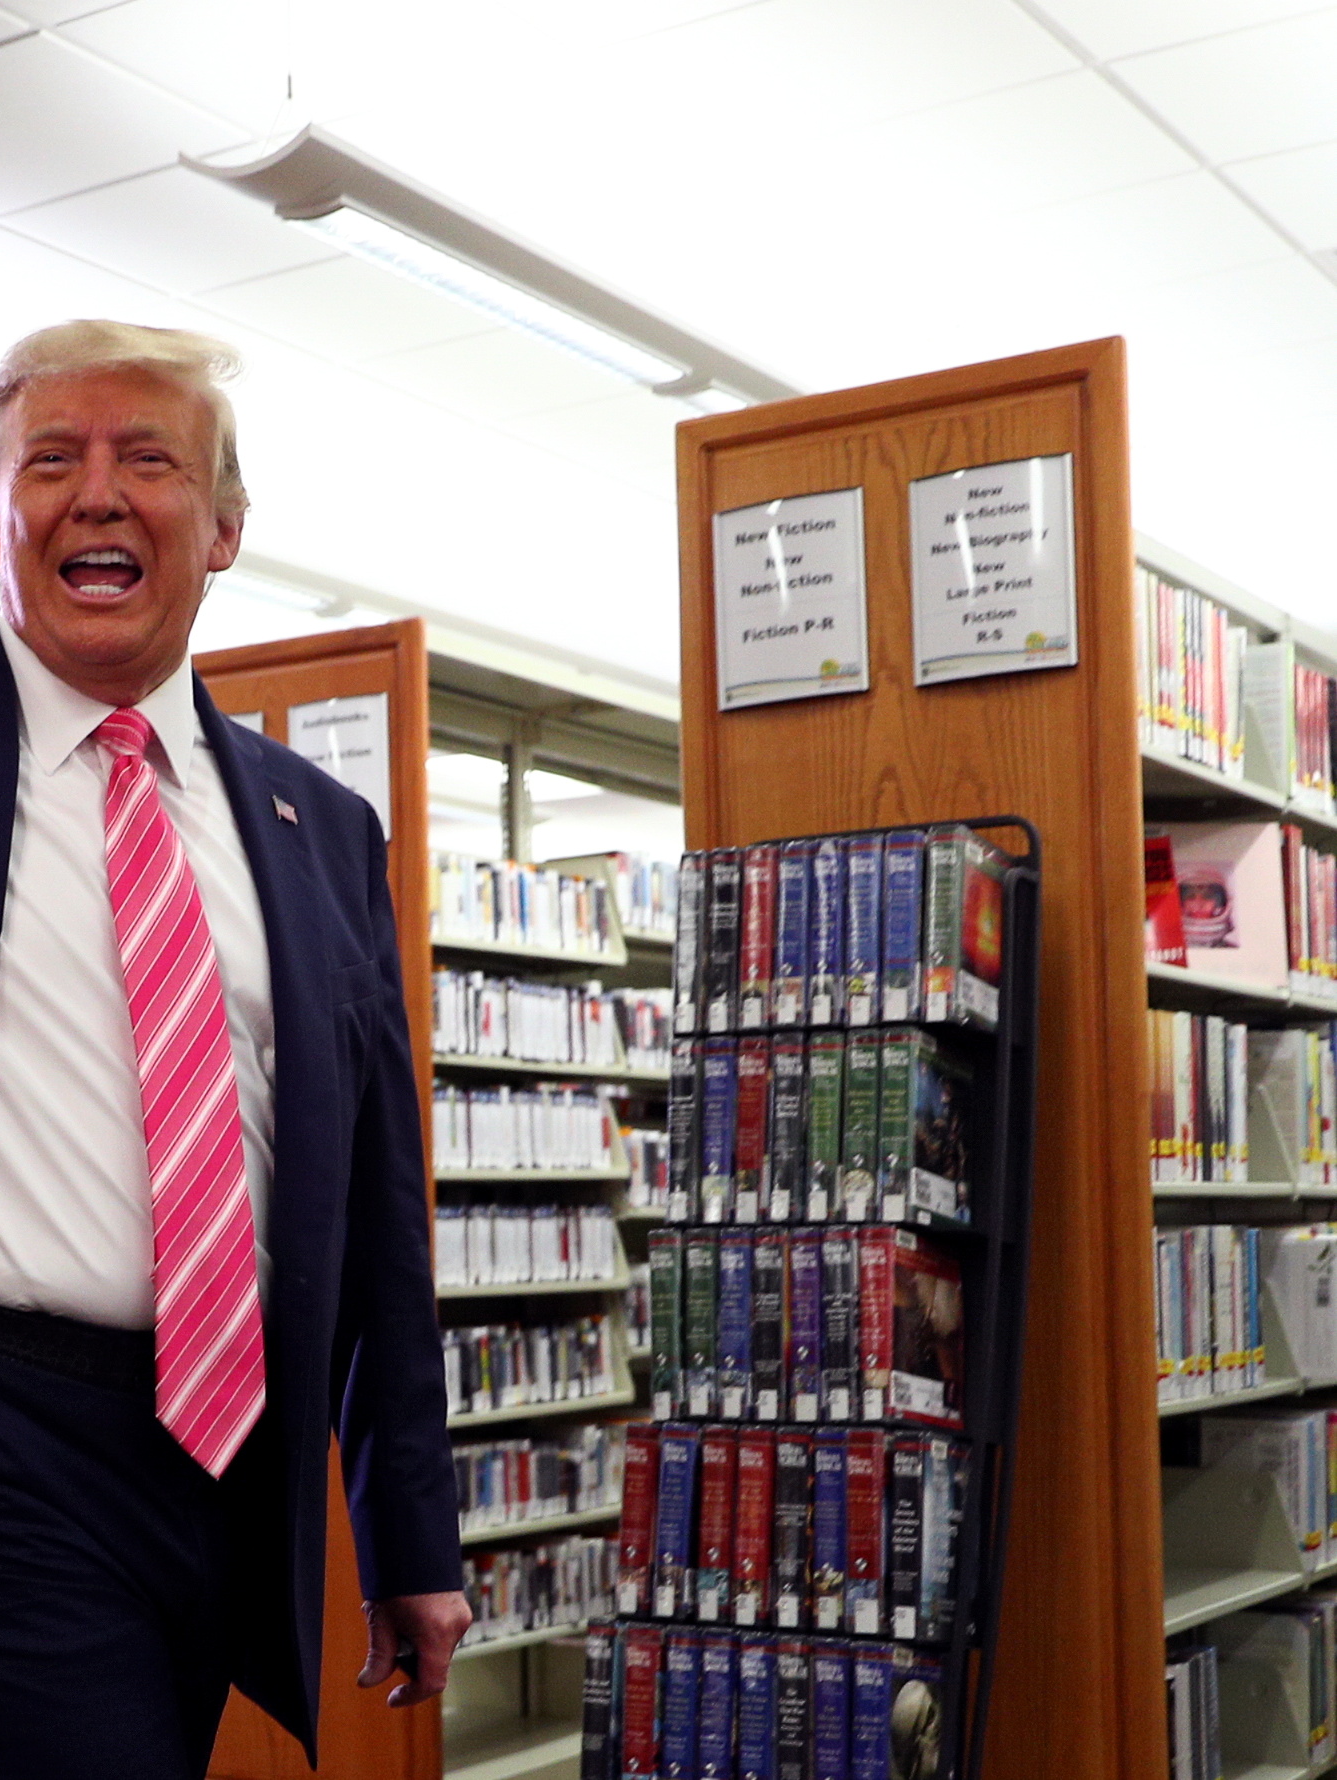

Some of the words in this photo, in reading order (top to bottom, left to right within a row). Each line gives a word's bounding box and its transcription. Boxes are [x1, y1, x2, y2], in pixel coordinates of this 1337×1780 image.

[967, 486, 1003, 501] New
[777, 518, 836, 537] Fiction
[994, 577, 1032, 593] Print
[963, 608, 1016, 625] Fiction
[743, 624, 798, 643] Fiction
